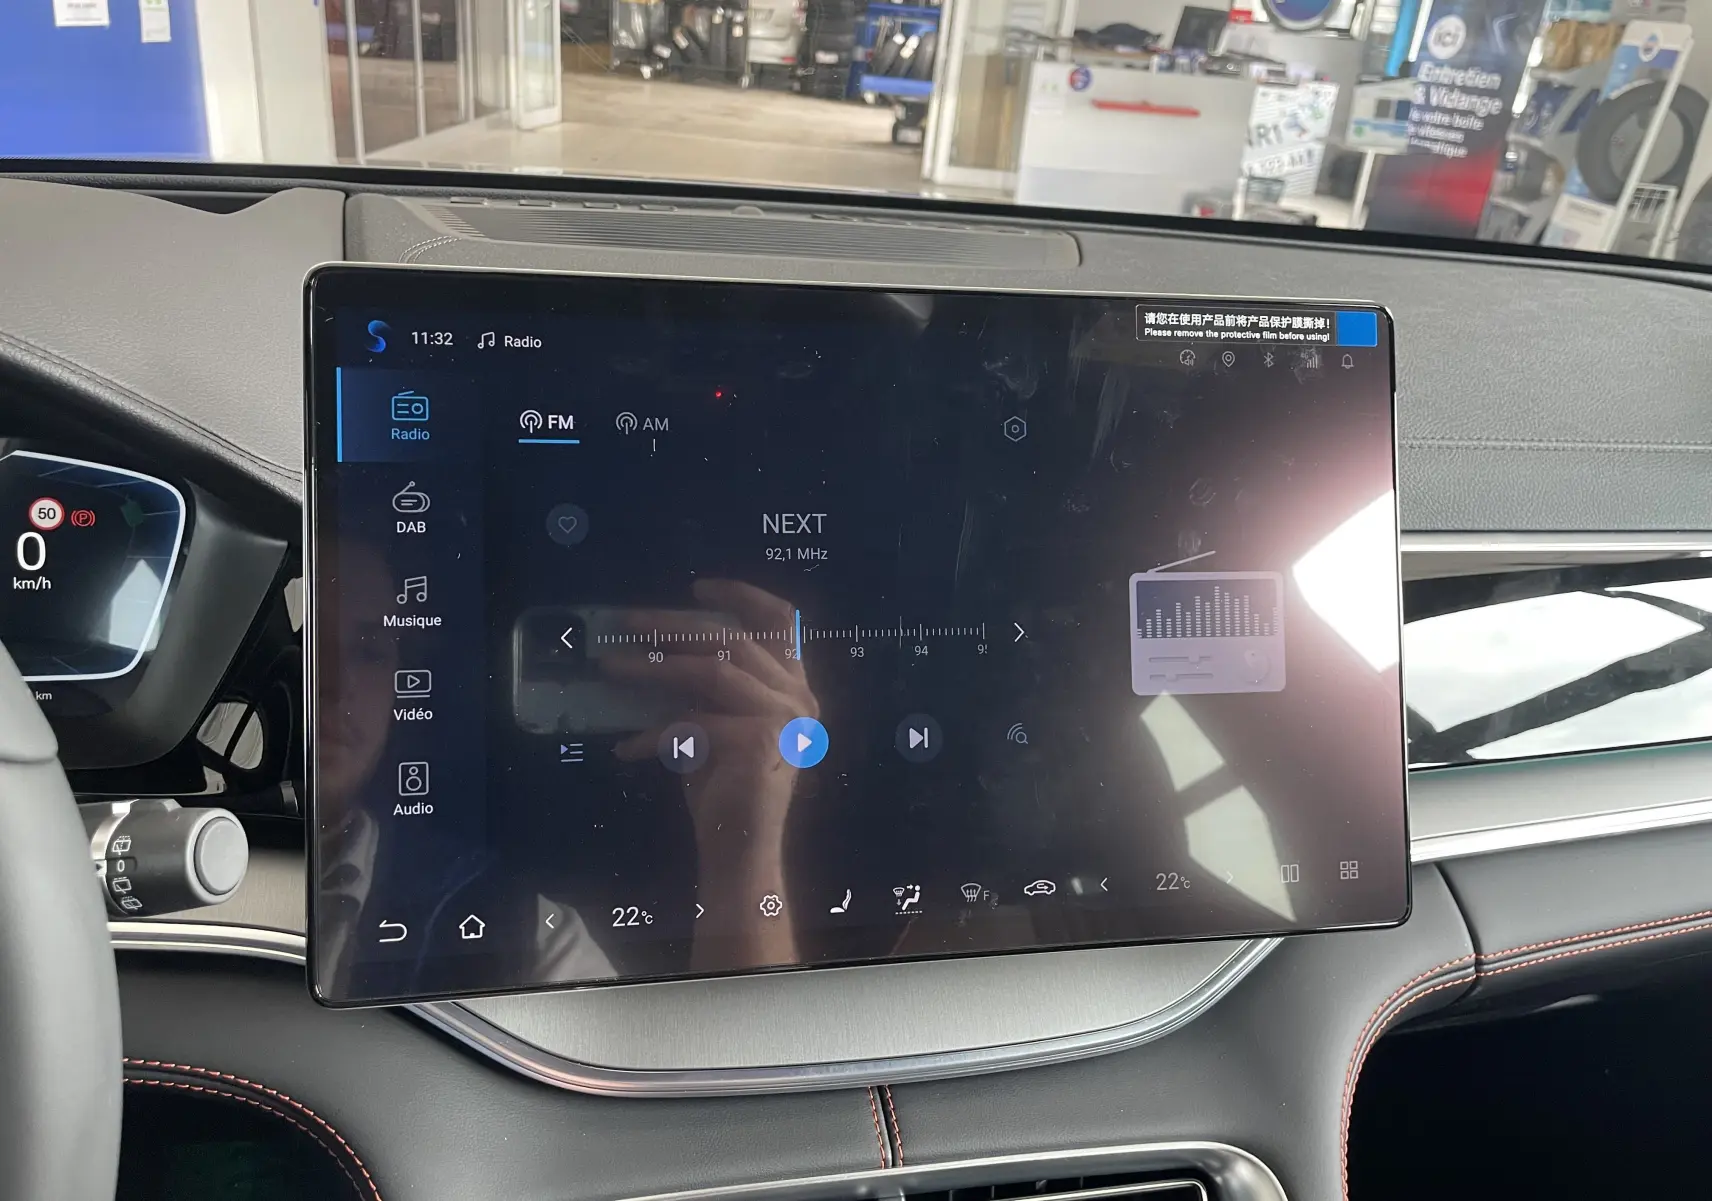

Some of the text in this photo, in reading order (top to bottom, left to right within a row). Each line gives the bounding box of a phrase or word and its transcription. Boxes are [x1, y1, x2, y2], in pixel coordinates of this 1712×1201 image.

[1417, 61, 1501, 90] Entretien
[1430, 86, 1502, 117] Vidange
[411, 332, 453, 345] 11:32
[504, 335, 542, 348] Radio
[1144, 328, 1330, 342] Please remove the protective film before using!
[548, 415, 574, 429] FM
[643, 417, 669, 431] AM
[391, 428, 430, 440] Radio
[37, 507, 57, 520] 50
[396, 521, 427, 533] DAB
[762, 513, 827, 534] NEXT
[17, 532, 46, 571] 0
[765, 548, 828, 562] 92,1 MHz
[13, 576, 51, 590] km/h
[383, 615, 442, 629] Musique
[648, 652, 664, 663] 90
[717, 650, 731, 661] 91
[850, 646, 865, 658] 93
[914, 645, 928, 656] 94
[36, 691, 52, 701] km
[393, 707, 433, 721] Vidéo
[393, 802, 434, 815] Audio
[117, 859, 125, 872] 0
